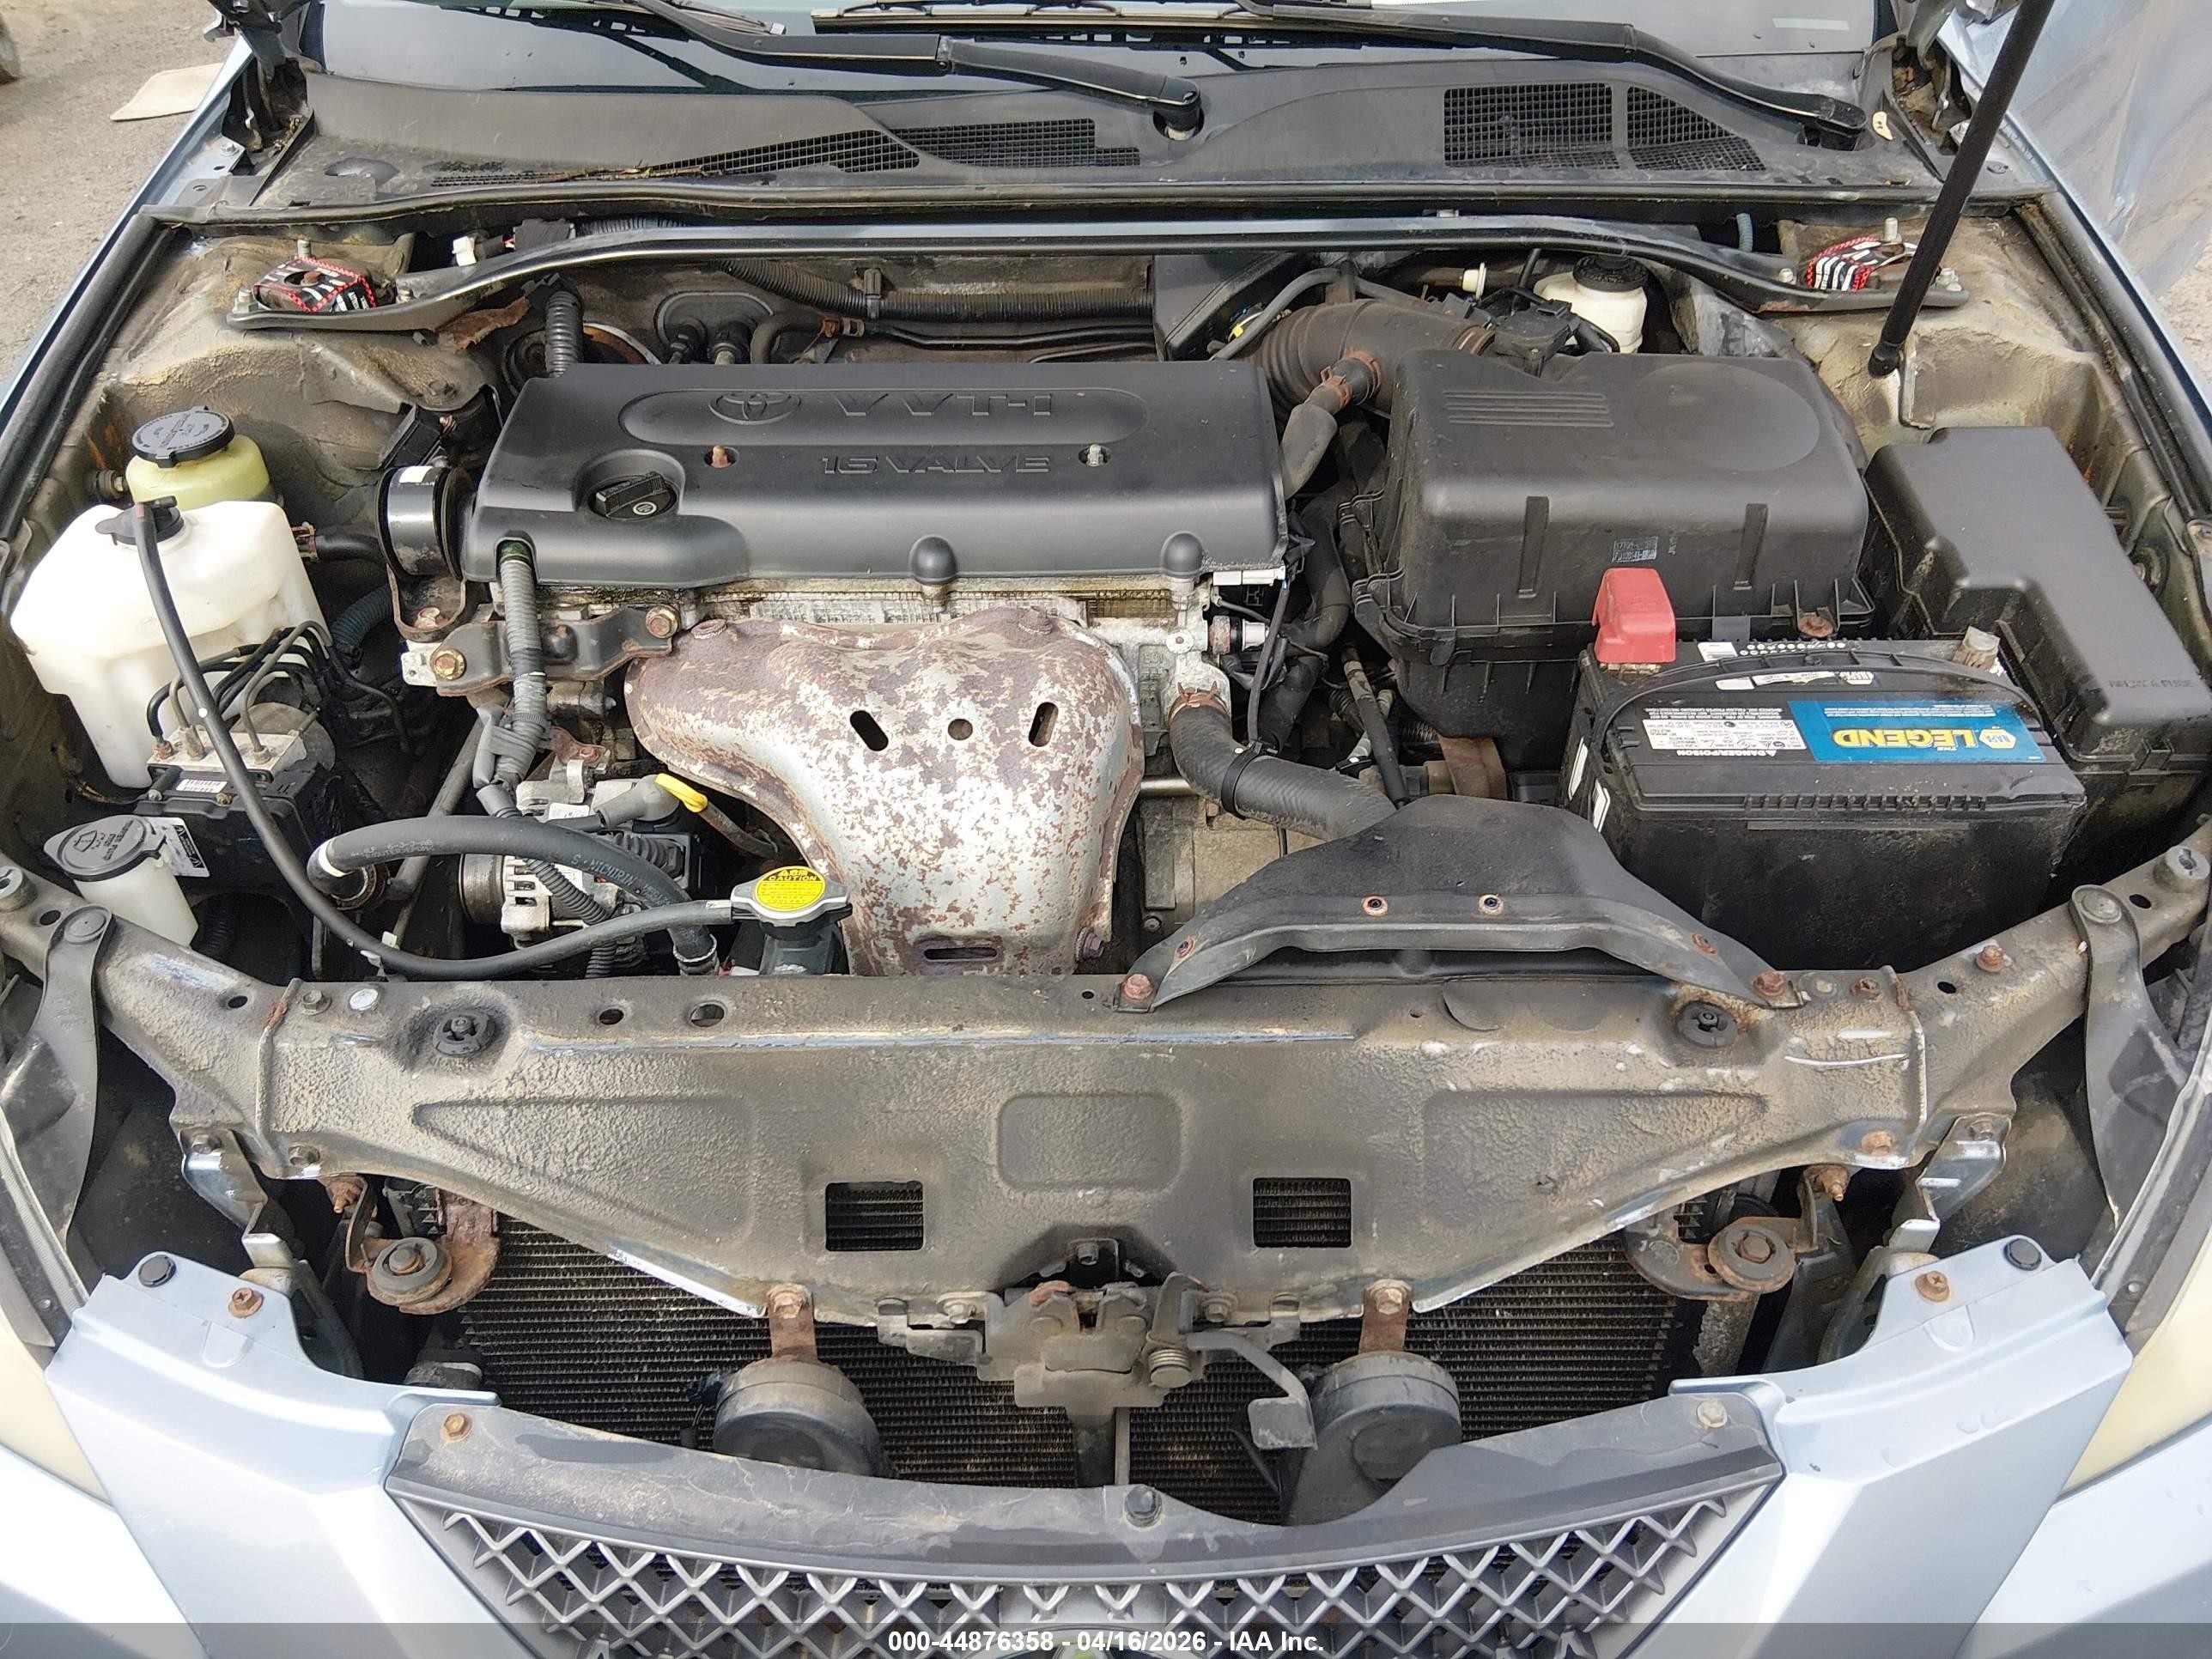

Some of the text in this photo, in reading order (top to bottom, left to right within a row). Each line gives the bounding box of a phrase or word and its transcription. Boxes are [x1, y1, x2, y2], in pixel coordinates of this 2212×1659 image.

[884, 455, 1050, 475] VALVE
[1832, 728, 1976, 749] LEGEND
[1985, 734, 2010, 744] NAPA
